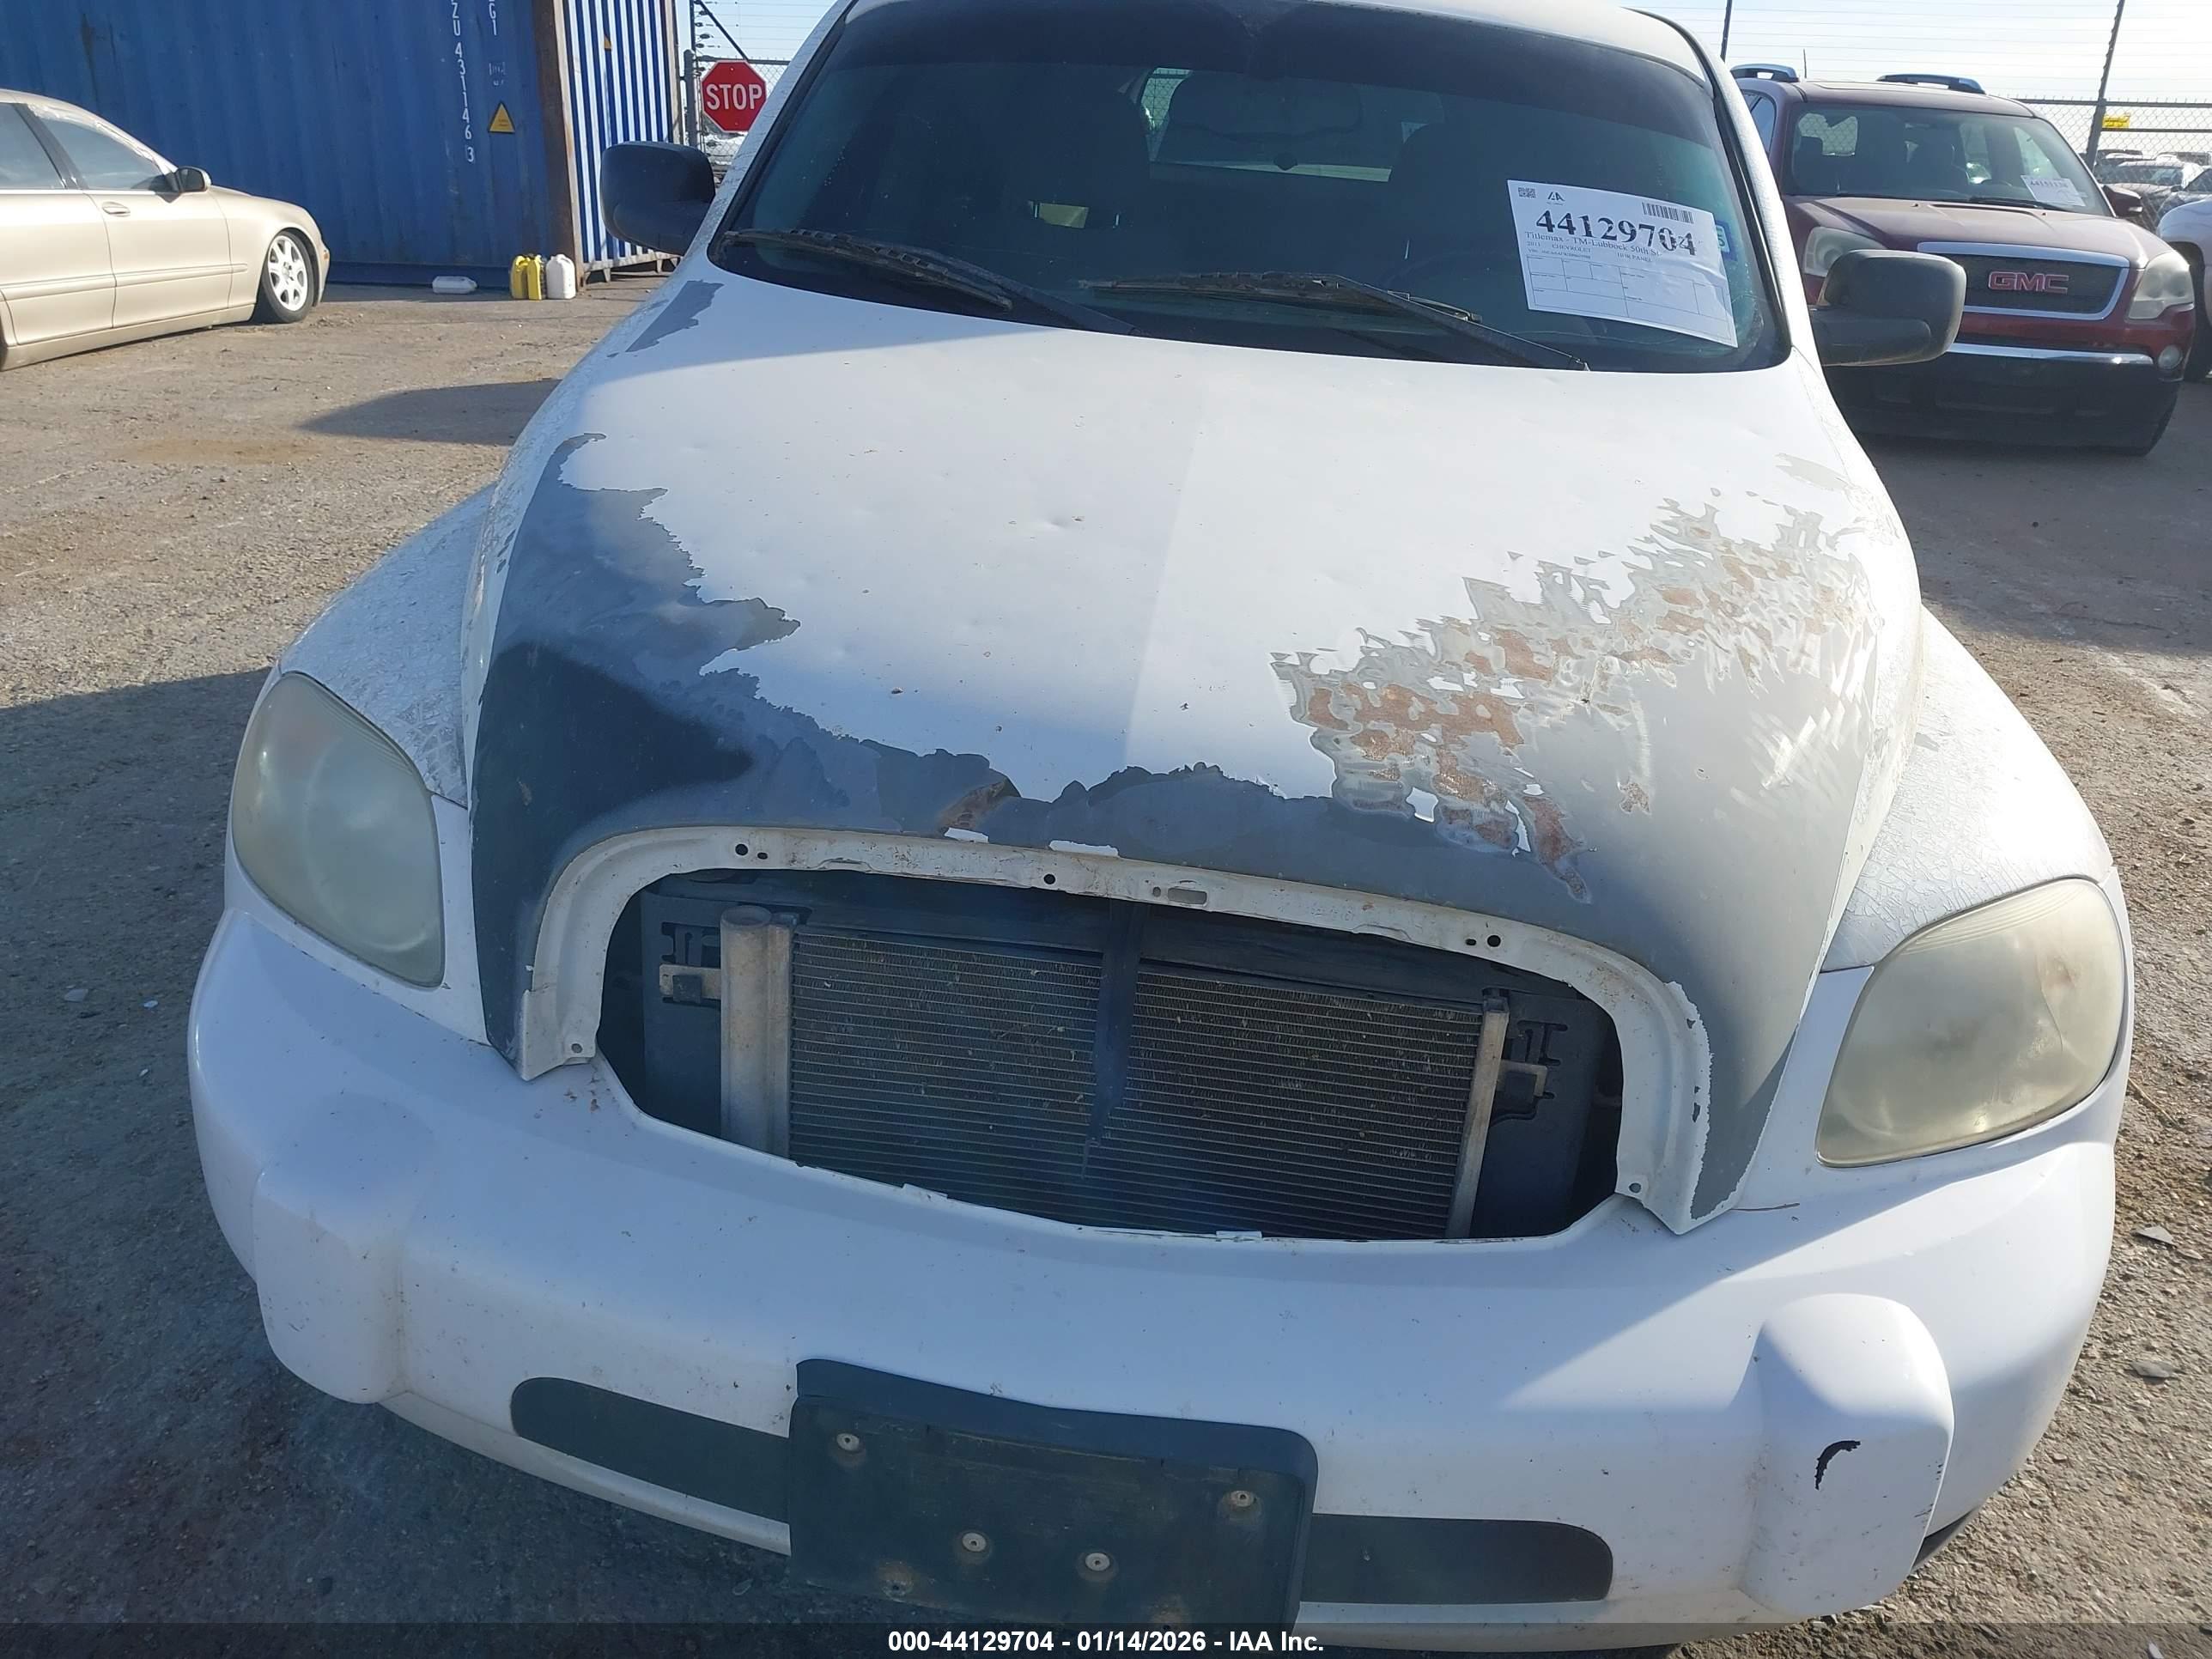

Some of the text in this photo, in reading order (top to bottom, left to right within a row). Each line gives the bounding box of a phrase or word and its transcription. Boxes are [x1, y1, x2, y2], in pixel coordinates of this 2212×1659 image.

[706, 83, 763, 110] STOP
[1525, 231, 1564, 242] Titlemax
[1572, 236, 1629, 252] TM-Lubbock
[1630, 245, 1649, 255] 50th
[1536, 210, 1696, 256] 44129704
[1988, 270, 2069, 295] GMC
